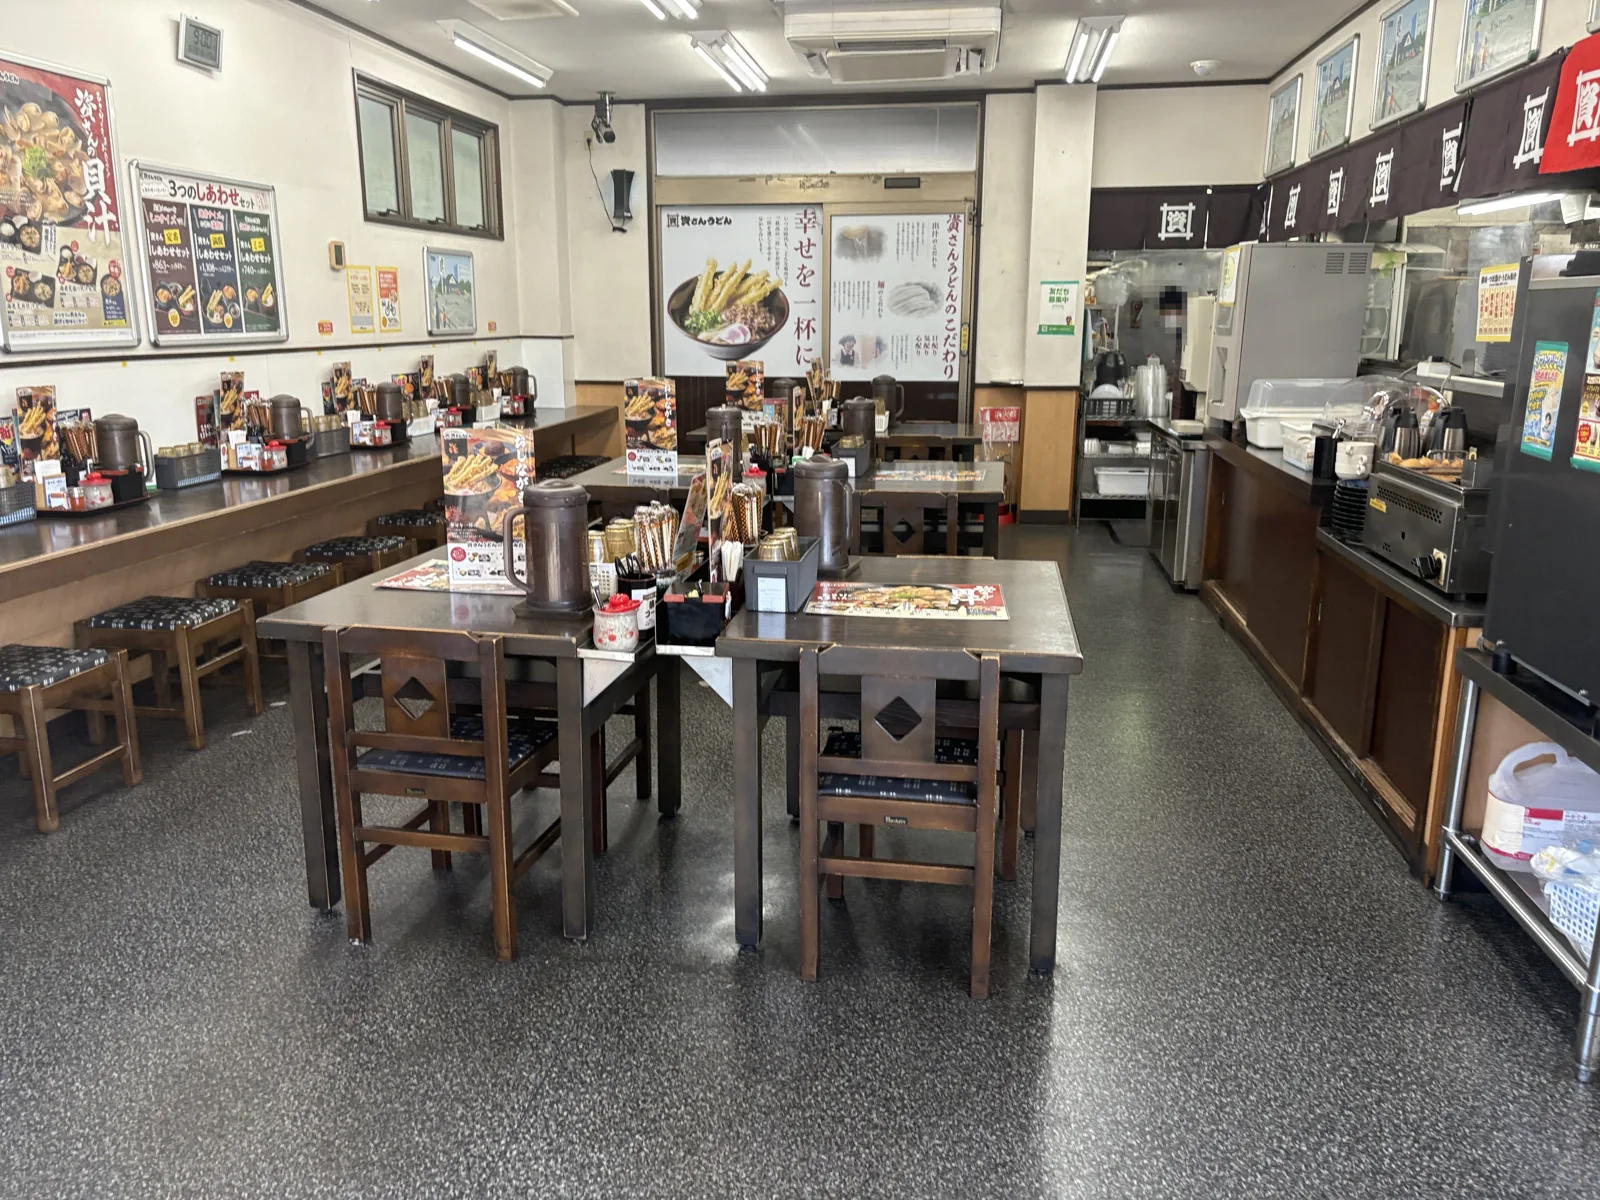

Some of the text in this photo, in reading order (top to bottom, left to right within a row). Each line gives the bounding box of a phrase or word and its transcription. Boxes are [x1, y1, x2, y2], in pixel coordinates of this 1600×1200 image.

[169, 180, 255, 209] 3つのしあわせセット
[680, 214, 733, 227] 資さんうどん
[151, 246, 190, 258] しあわせセット
[199, 249, 233, 261] しあわせセット
[931, 222, 940, 269] 出汁のこだわり
[240, 252, 271, 264] しあわせセット
[793, 209, 817, 366] 幸せを一杯に
[942, 213, 963, 380] 資さんうどんのこだわり
